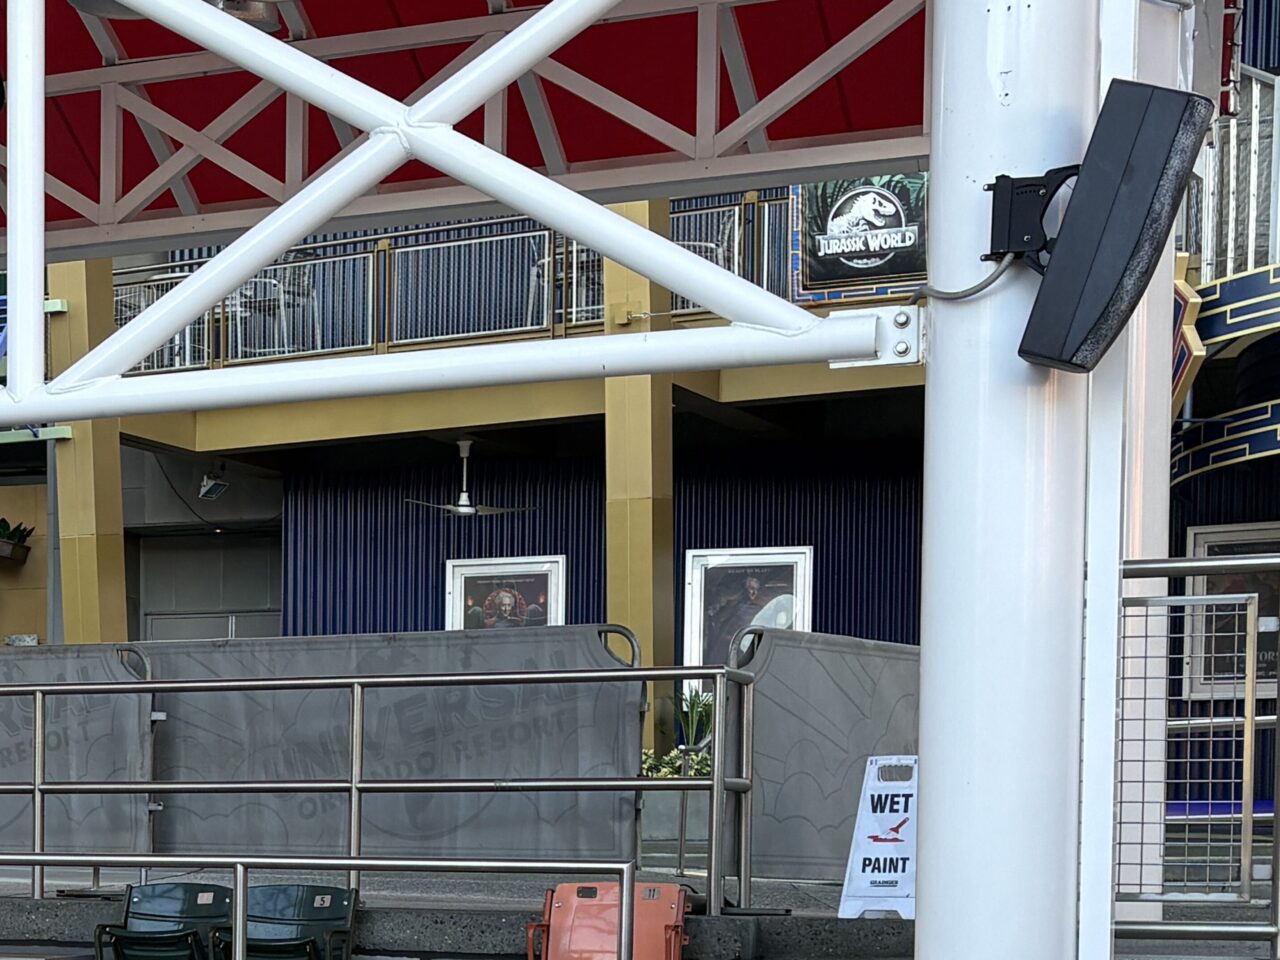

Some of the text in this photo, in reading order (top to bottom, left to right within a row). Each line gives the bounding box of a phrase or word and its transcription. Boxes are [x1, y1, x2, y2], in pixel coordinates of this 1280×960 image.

[818, 231, 915, 256] JURASSIC WORLD
[0, 722, 91, 768] REORT
[870, 793, 913, 814] WET
[861, 857, 910, 874] PAINT
